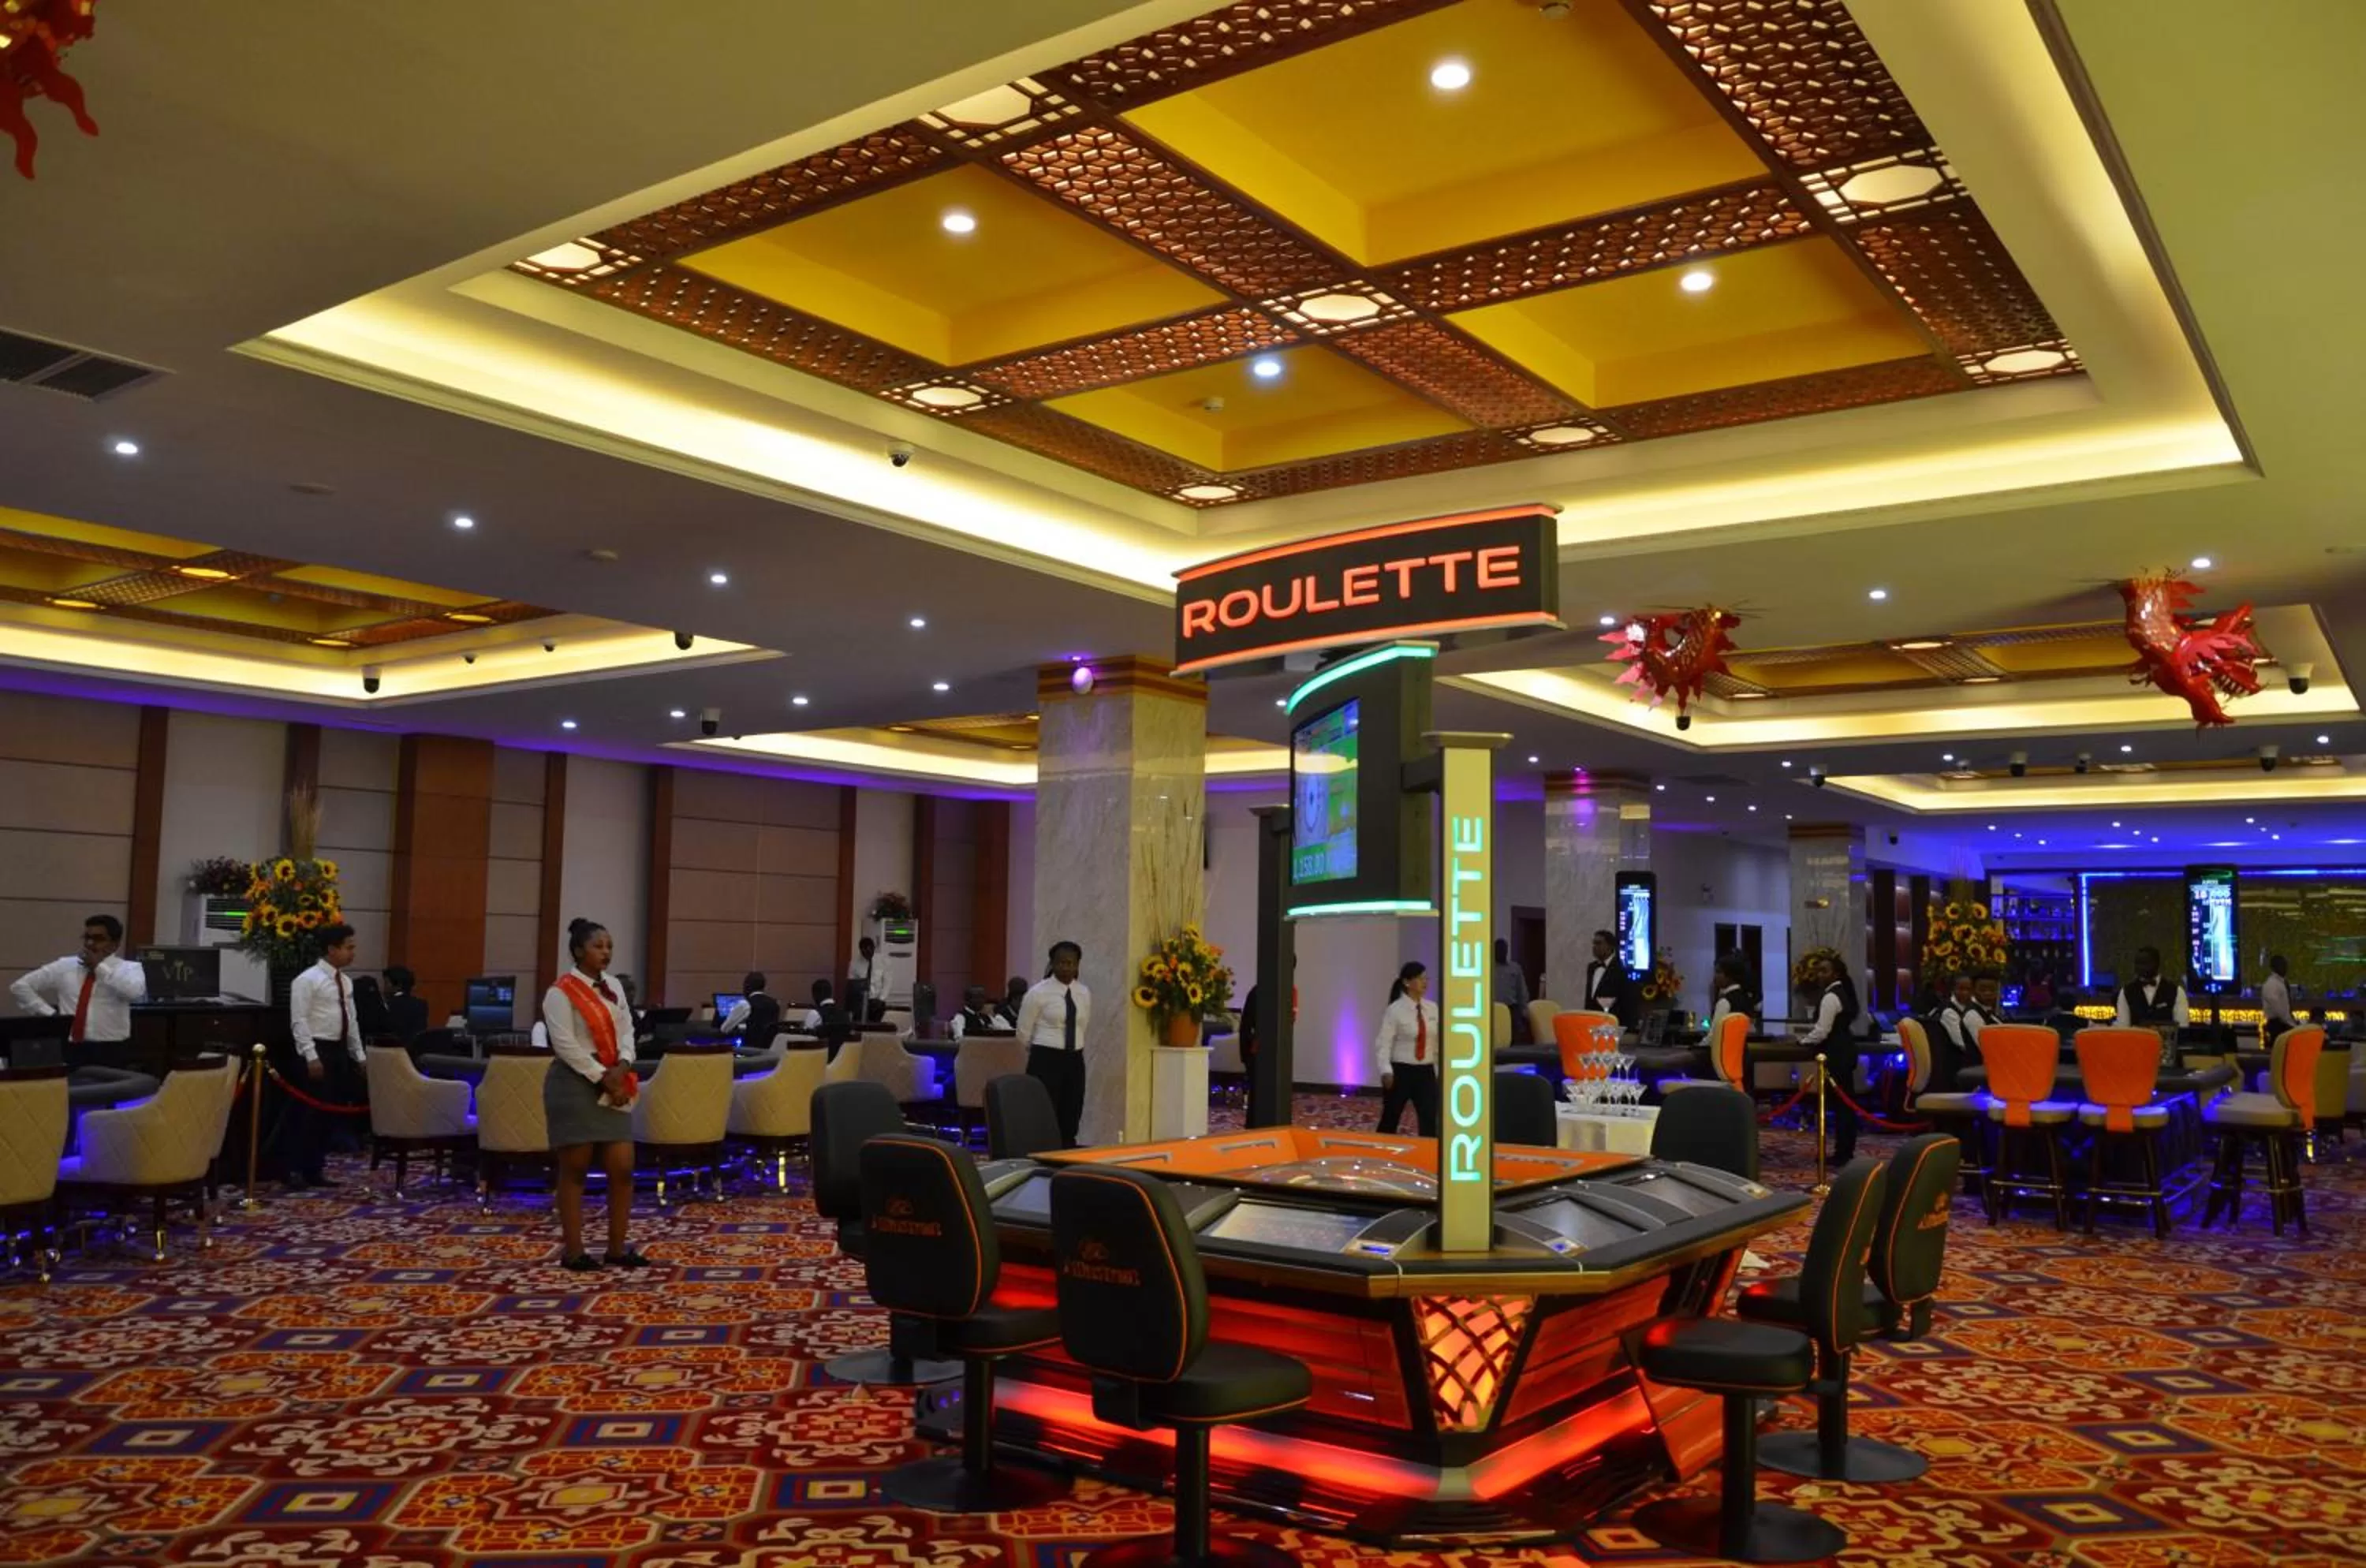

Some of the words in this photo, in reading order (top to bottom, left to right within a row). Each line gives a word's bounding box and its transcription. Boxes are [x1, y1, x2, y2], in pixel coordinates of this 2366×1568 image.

[1183, 546, 1520, 638] ROULETTE
[161, 961, 194, 982] VIP
[1450, 817, 1482, 1181] ROULETTE
